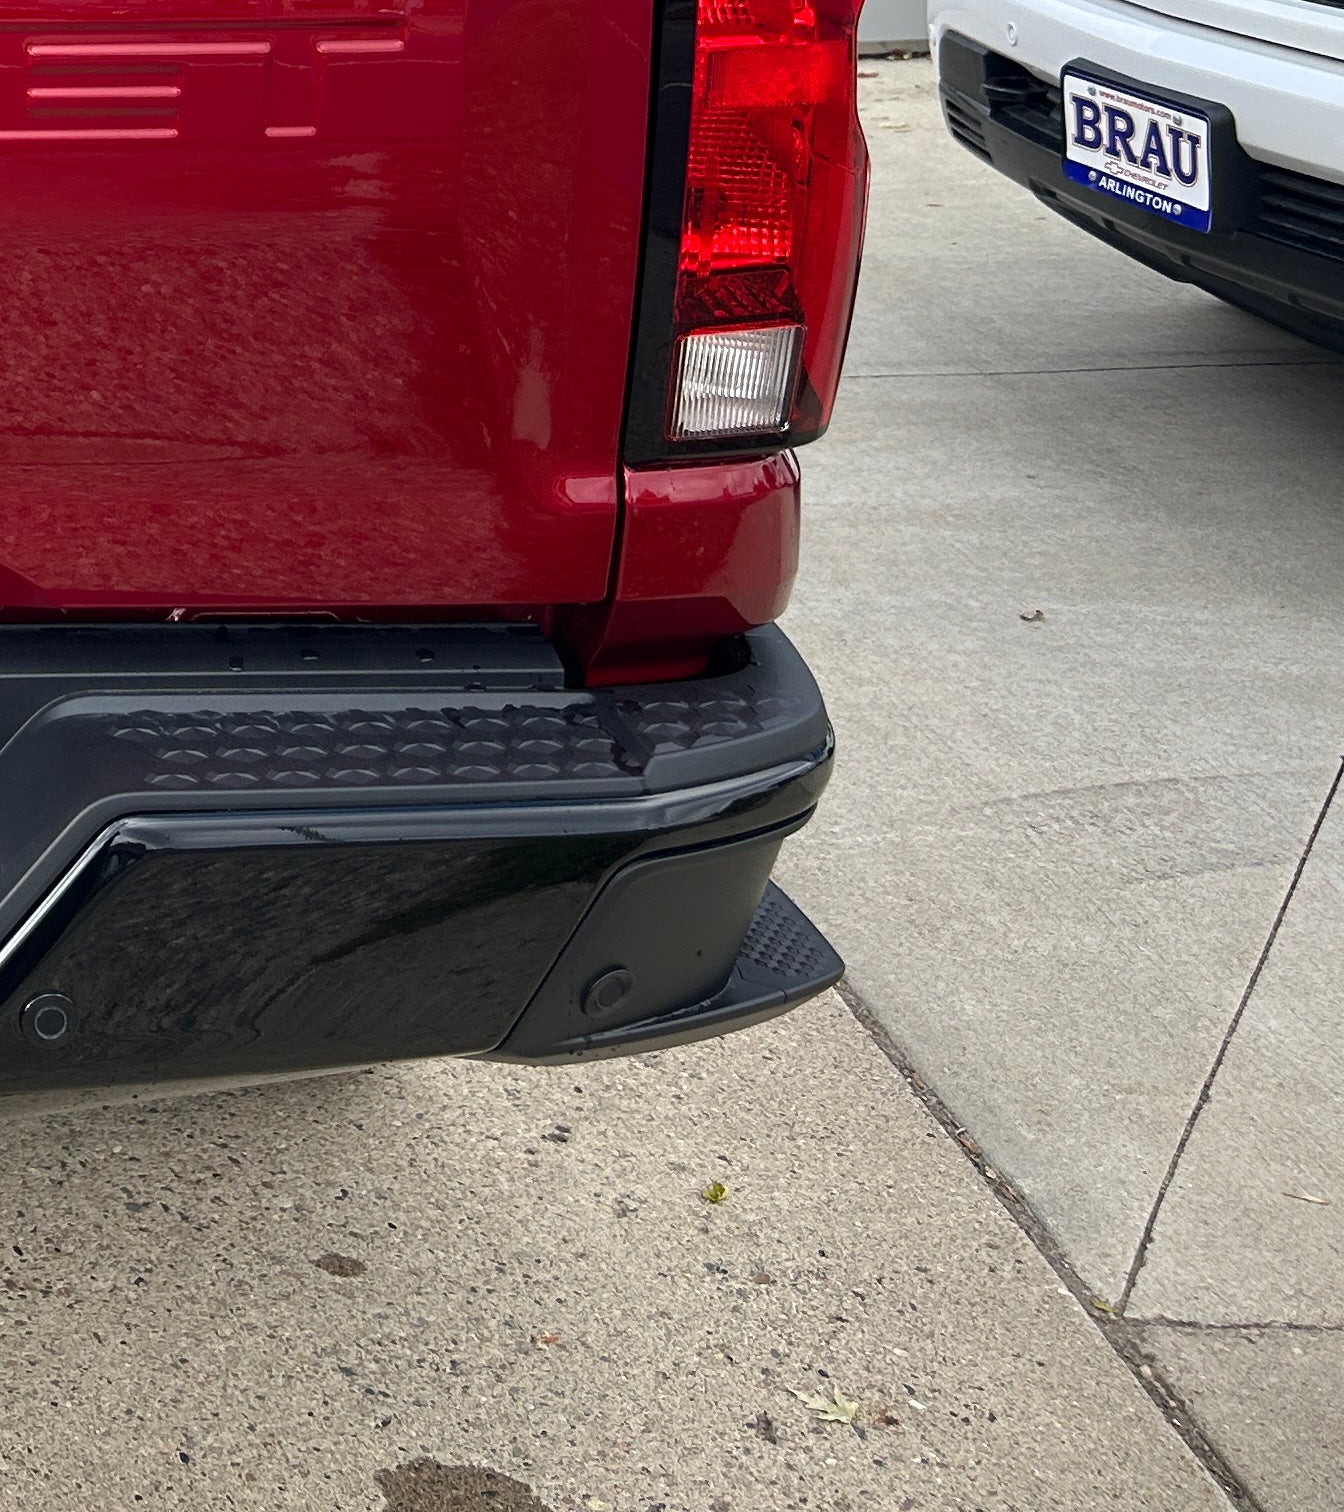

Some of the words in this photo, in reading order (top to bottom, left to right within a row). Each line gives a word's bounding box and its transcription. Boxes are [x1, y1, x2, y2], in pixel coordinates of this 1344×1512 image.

[1069, 92, 1201, 188] BRAU
[1098, 175, 1172, 214] ARLINGTON
[1123, 168, 1169, 191] CHEVROLET
